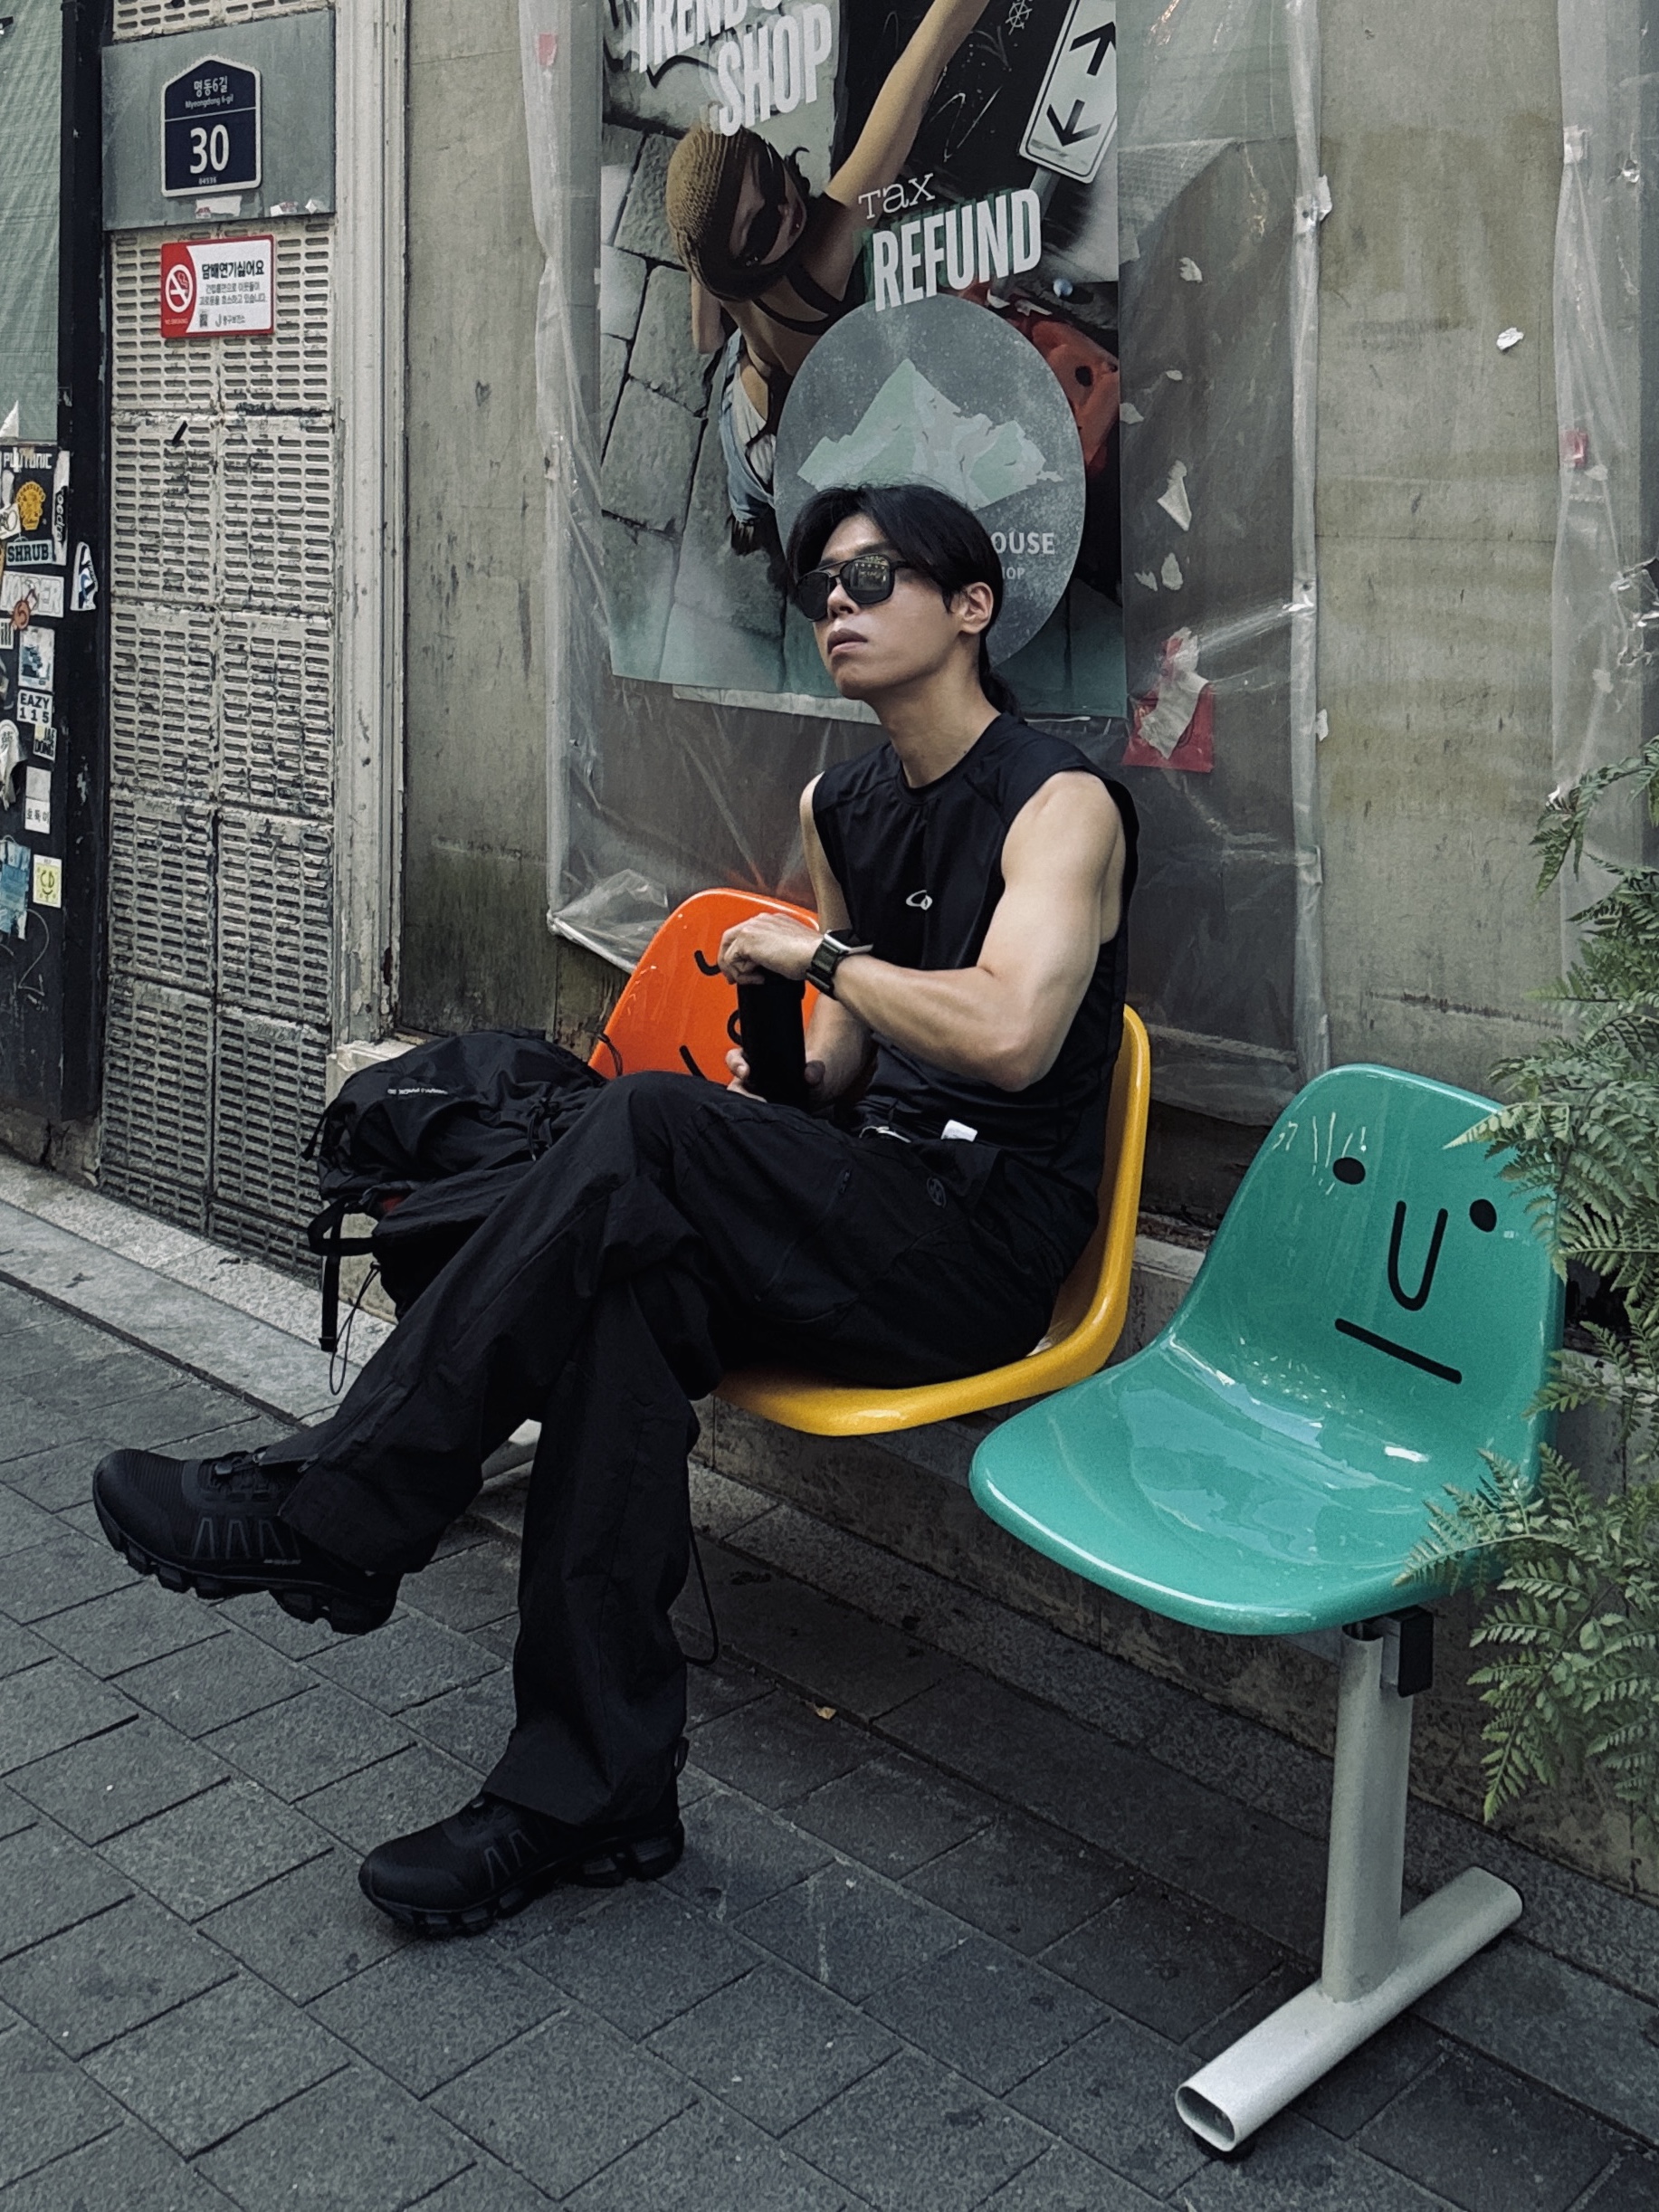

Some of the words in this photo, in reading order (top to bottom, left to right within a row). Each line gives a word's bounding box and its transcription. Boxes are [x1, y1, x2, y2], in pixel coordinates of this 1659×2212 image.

[718, 3, 833, 137] SHOP
[193, 75, 228, 98] 명동6길
[185, 97, 221, 110] Myeongdong
[189, 124, 230, 175] 30
[872, 188, 1042, 313] REFUND
[7, 543, 49, 563] SHRUB
[20, 692, 50, 710] EAZY
